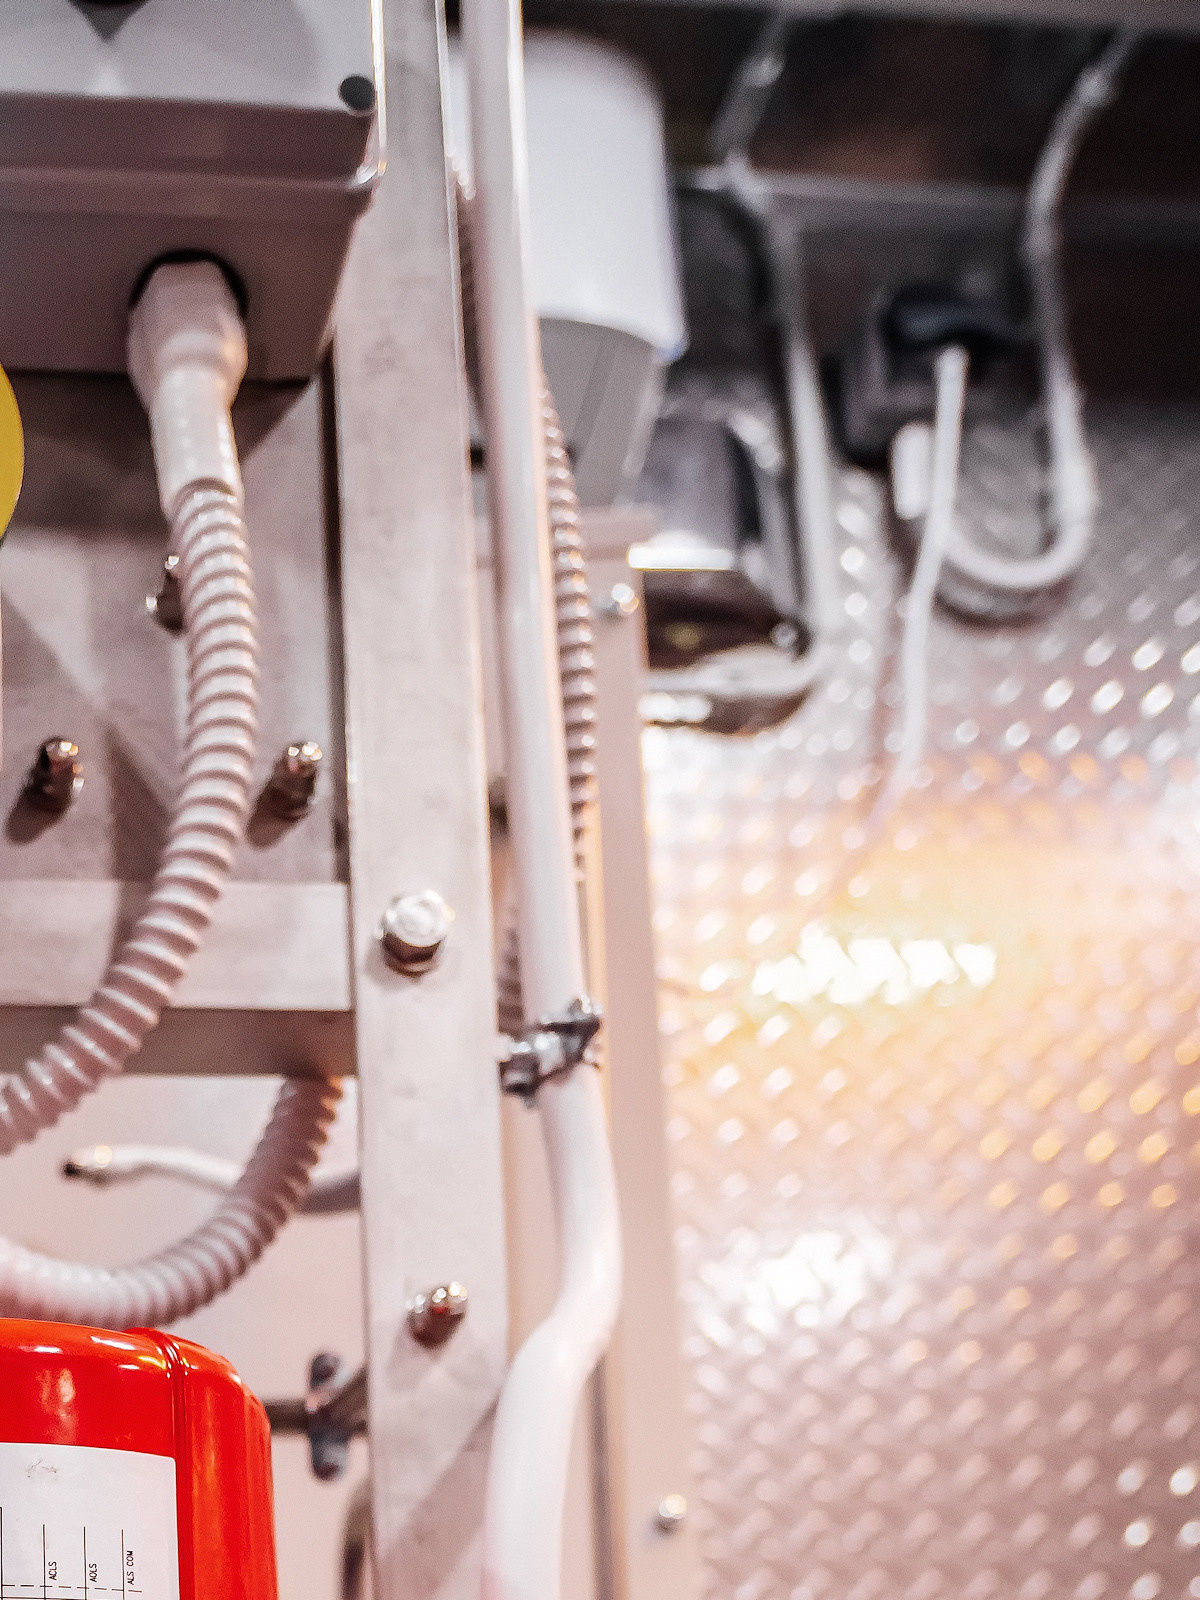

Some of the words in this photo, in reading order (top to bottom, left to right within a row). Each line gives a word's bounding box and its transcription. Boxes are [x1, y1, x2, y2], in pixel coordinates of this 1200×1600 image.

[126, 1550, 134, 1567] COM
[48, 1561, 57, 1581] ACLS
[89, 1563, 97, 1583] AOLS
